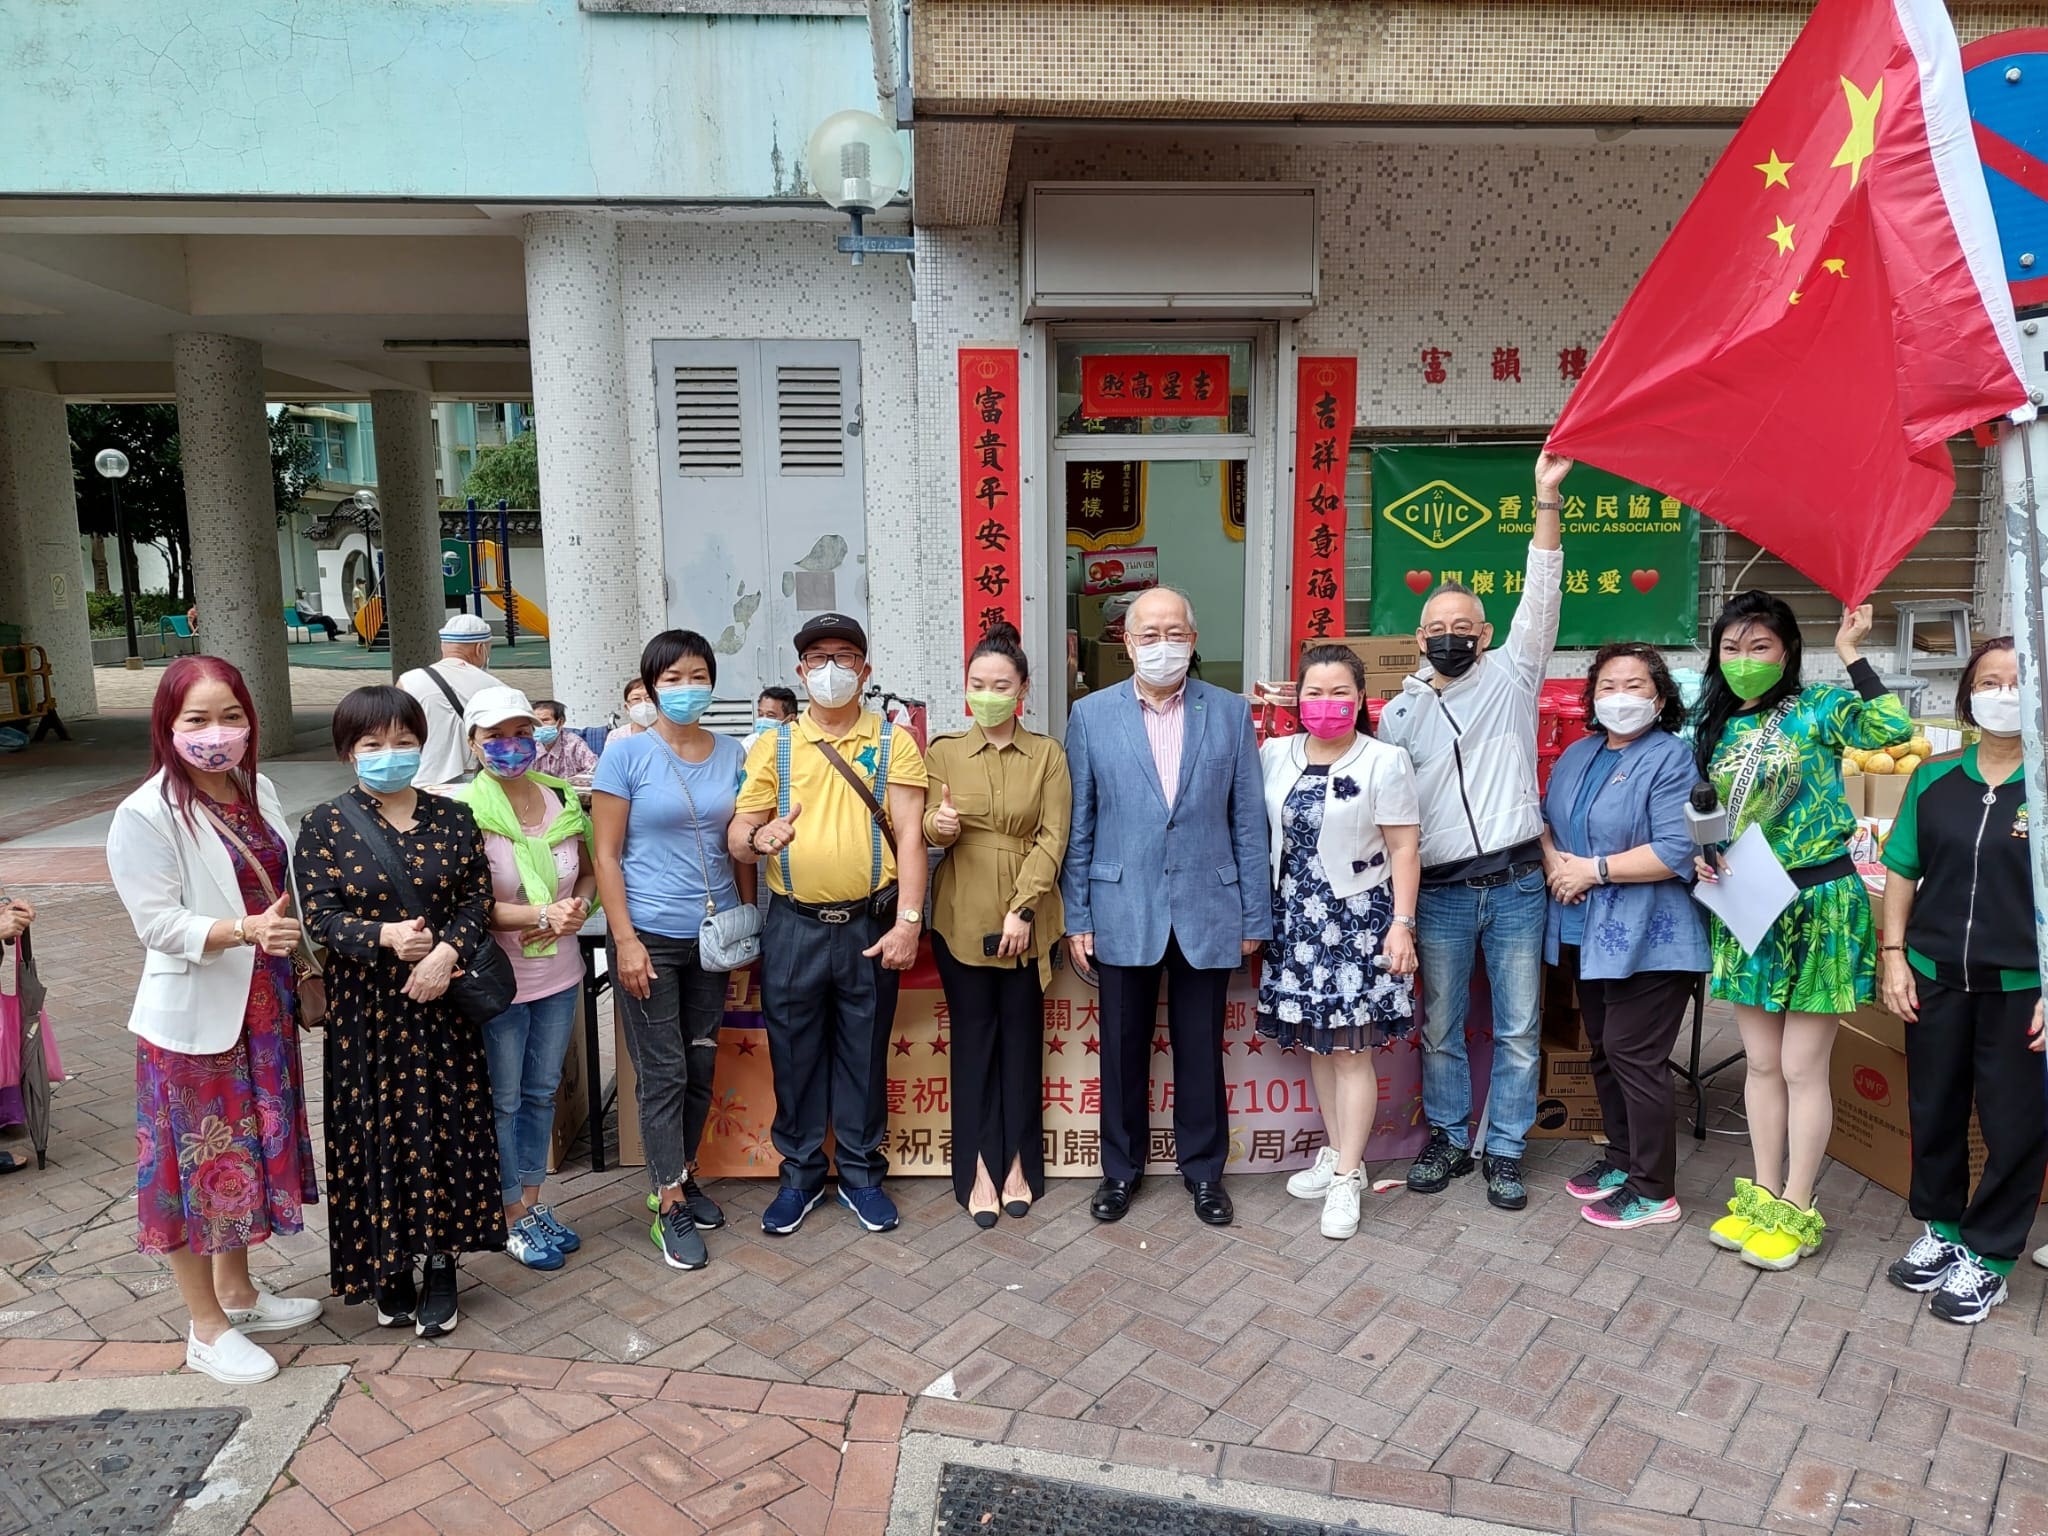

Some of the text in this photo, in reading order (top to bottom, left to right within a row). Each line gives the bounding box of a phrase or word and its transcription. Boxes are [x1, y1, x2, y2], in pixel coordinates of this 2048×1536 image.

[1421, 346, 1588, 384] 富韻樓
[1433, 489, 1444, 500] 公
[1306, 391, 1338, 637] 吉祥如意福星
[1405, 502, 1470, 529] CIVIC
[1498, 495, 1682, 520] 香公民協會
[1432, 529, 1445, 542] 民
[1498, 523, 1681, 533] HONGG CIVIC ASSOCIATION
[1441, 569, 1622, 595] 懷社送愛
